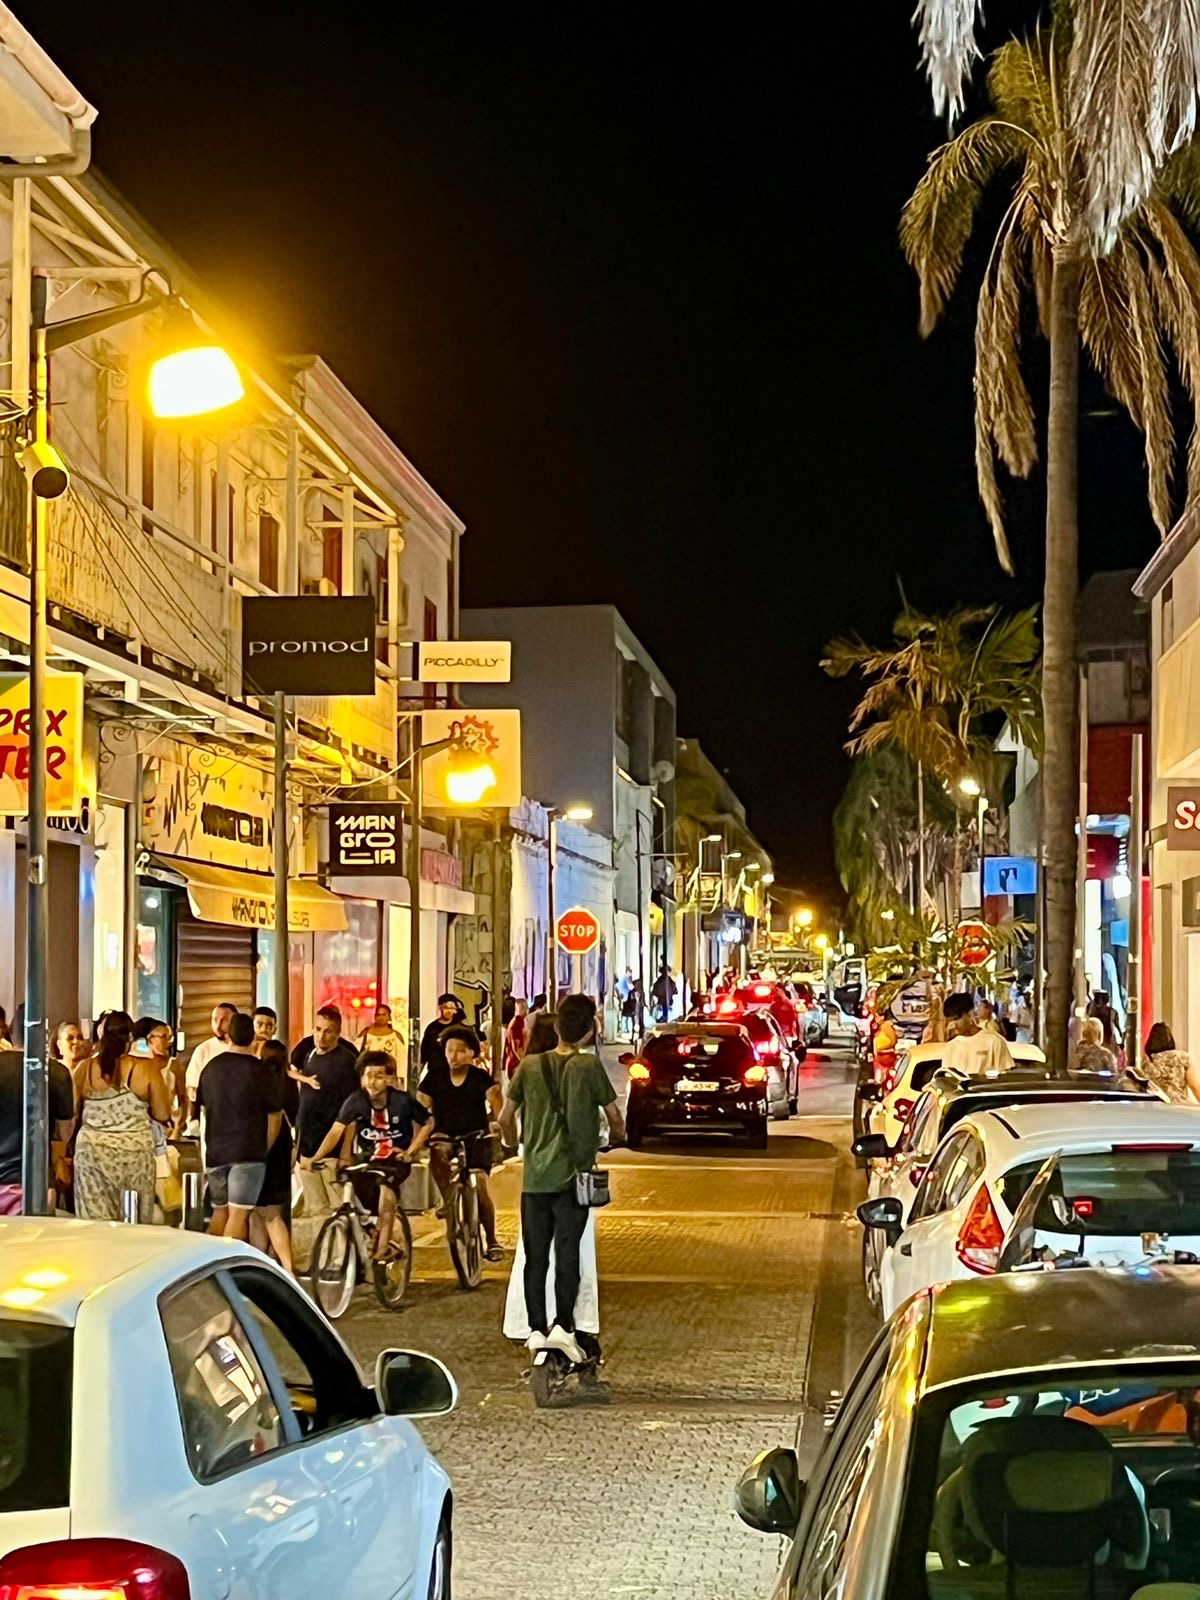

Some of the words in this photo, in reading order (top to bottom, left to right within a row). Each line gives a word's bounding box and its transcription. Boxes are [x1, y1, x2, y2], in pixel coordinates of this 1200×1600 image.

[248, 637, 369, 656] promod
[424, 657, 499, 667] PICCADILLY
[0, 708, 67, 736] PRX
[335, 815, 396, 830] MAN
[1174, 800, 1200, 830] S
[559, 924, 595, 938] STOP
